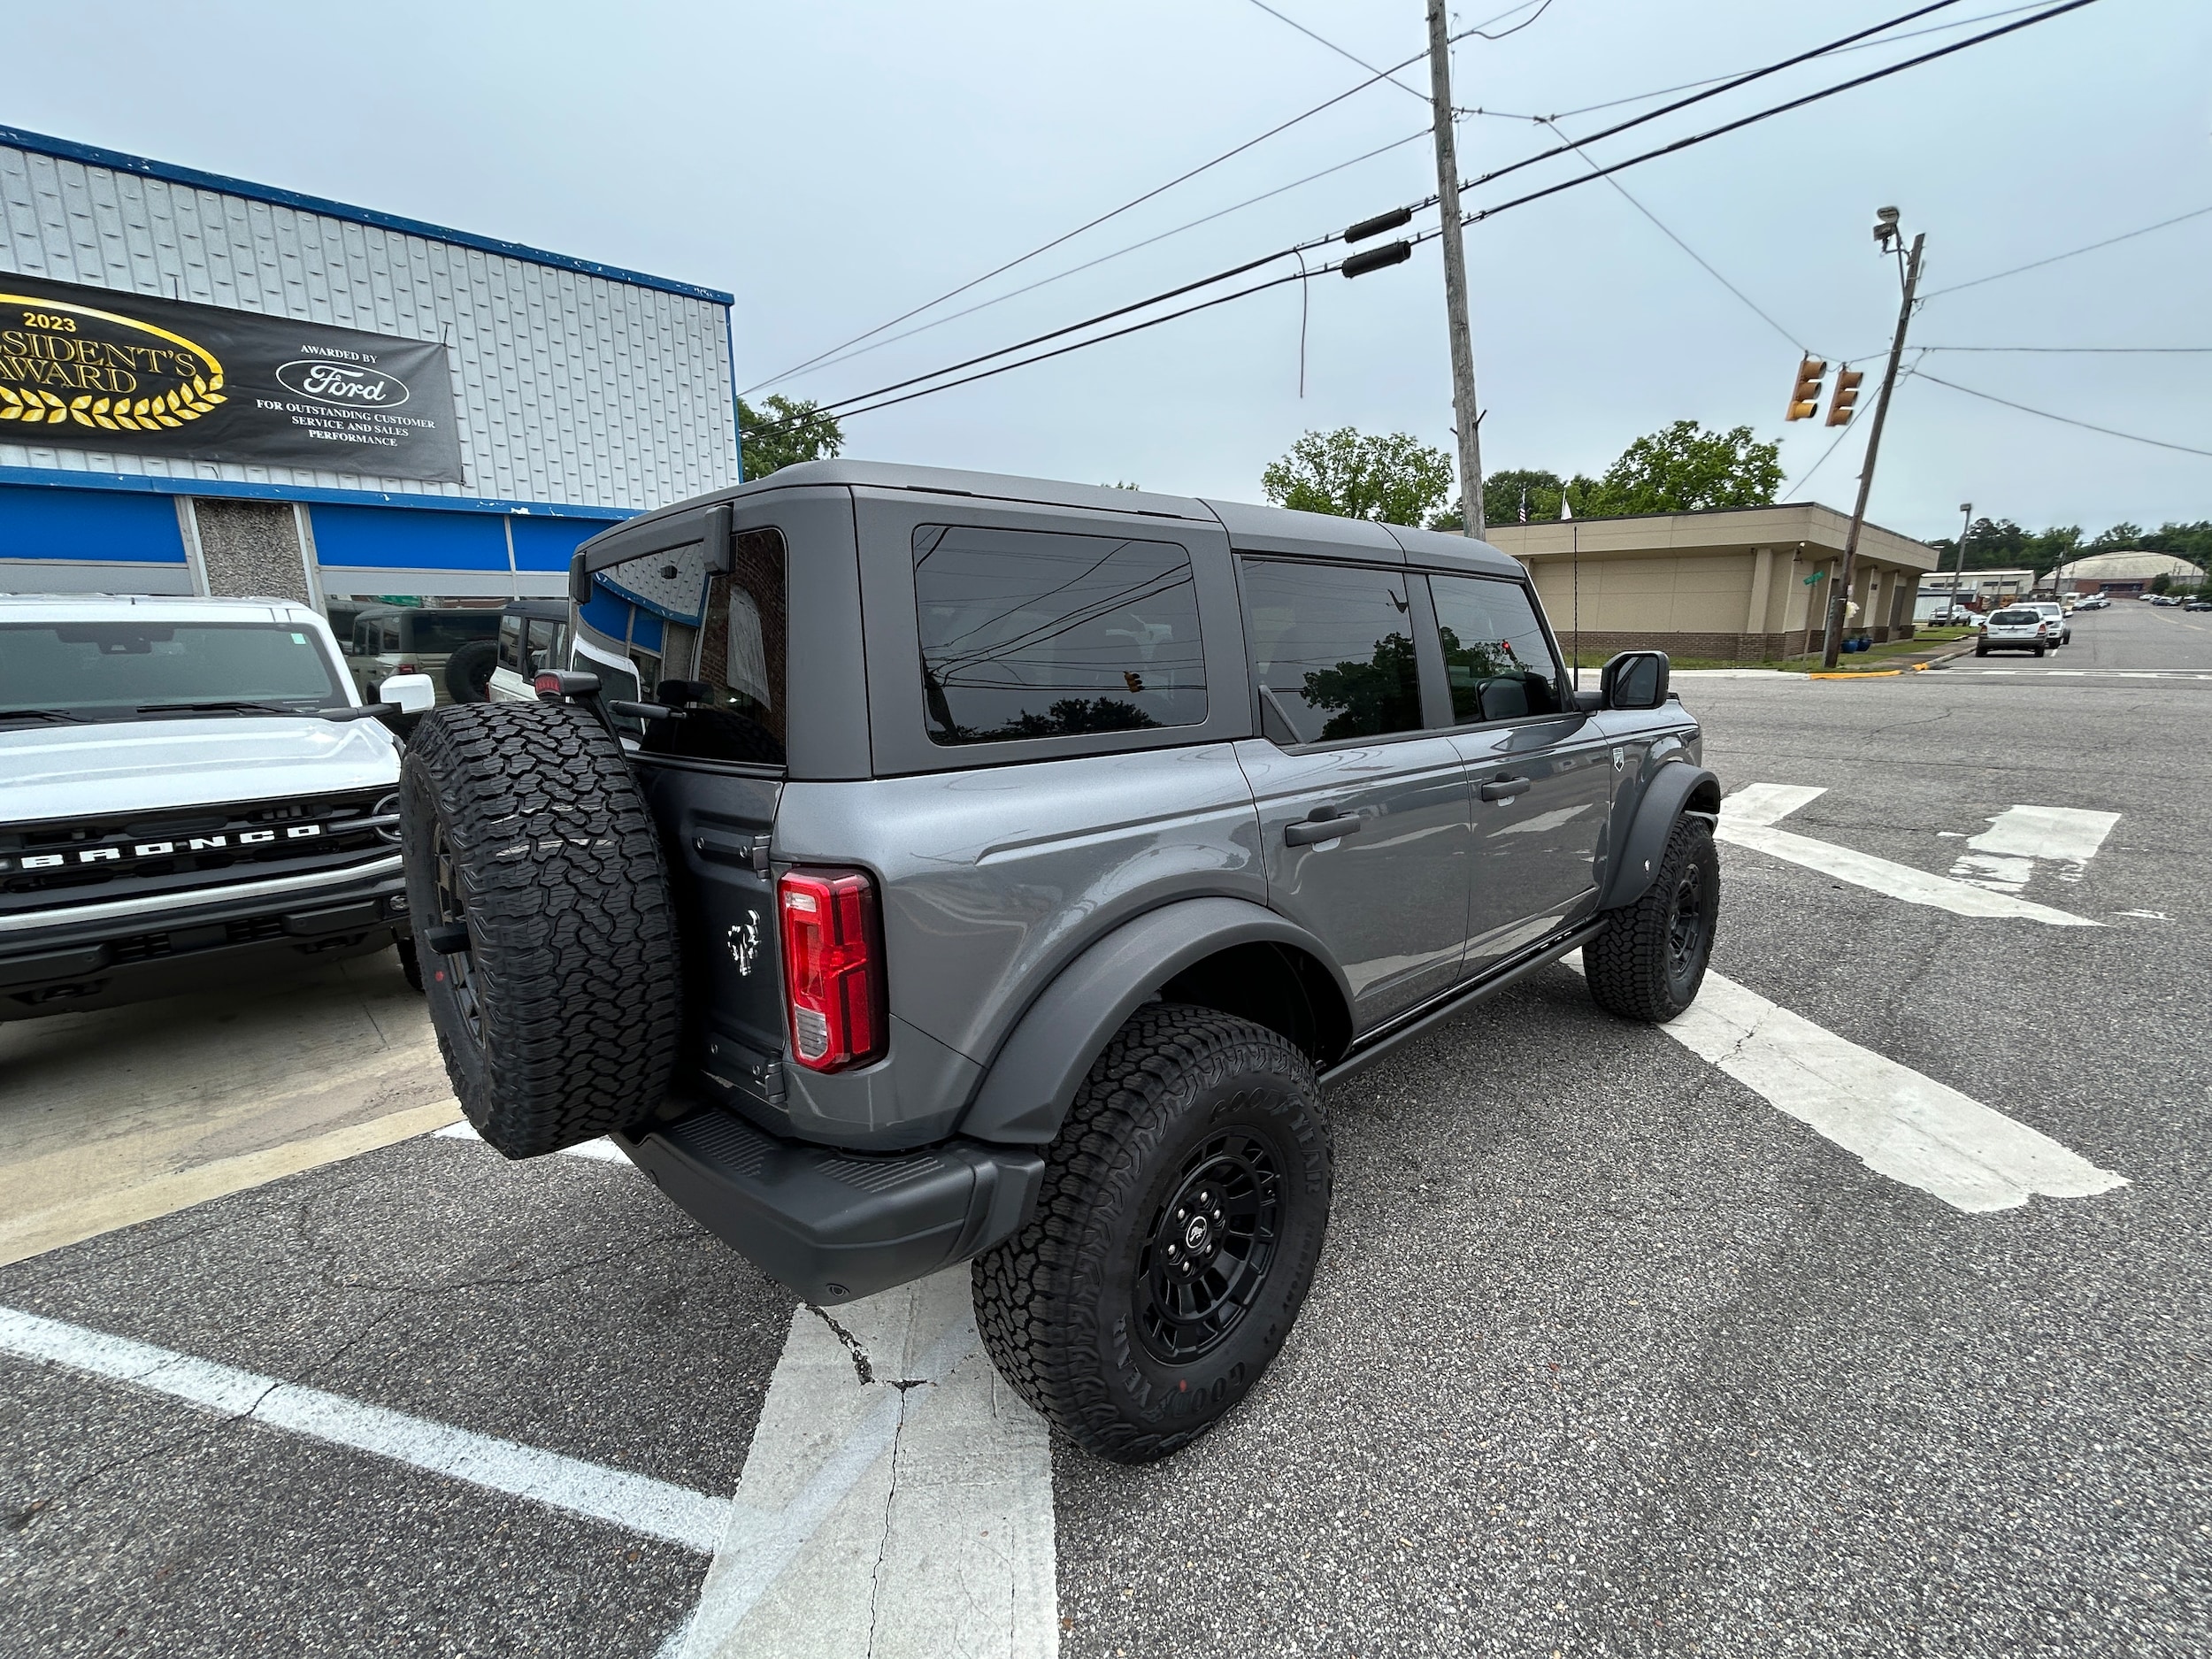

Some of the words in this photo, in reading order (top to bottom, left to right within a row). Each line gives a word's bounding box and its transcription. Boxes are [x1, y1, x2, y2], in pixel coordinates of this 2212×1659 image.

[22, 311, 77, 333] 2023
[0, 330, 197, 378] SIDENT'S
[301, 344, 359, 361] AWARDED
[363, 350, 378, 364] BY
[303, 365, 387, 402] Ford
[256, 399, 283, 411] FOR
[286, 403, 371, 421] OUTSTANDING
[374, 413, 436, 429] CUSTOMER
[291, 416, 344, 430] SERVICE
[348, 421, 372, 433] AND
[374, 425, 409, 437] SALES
[308, 429, 398, 447] PERFORMANCE
[21, 825, 321, 869] BRONCO
